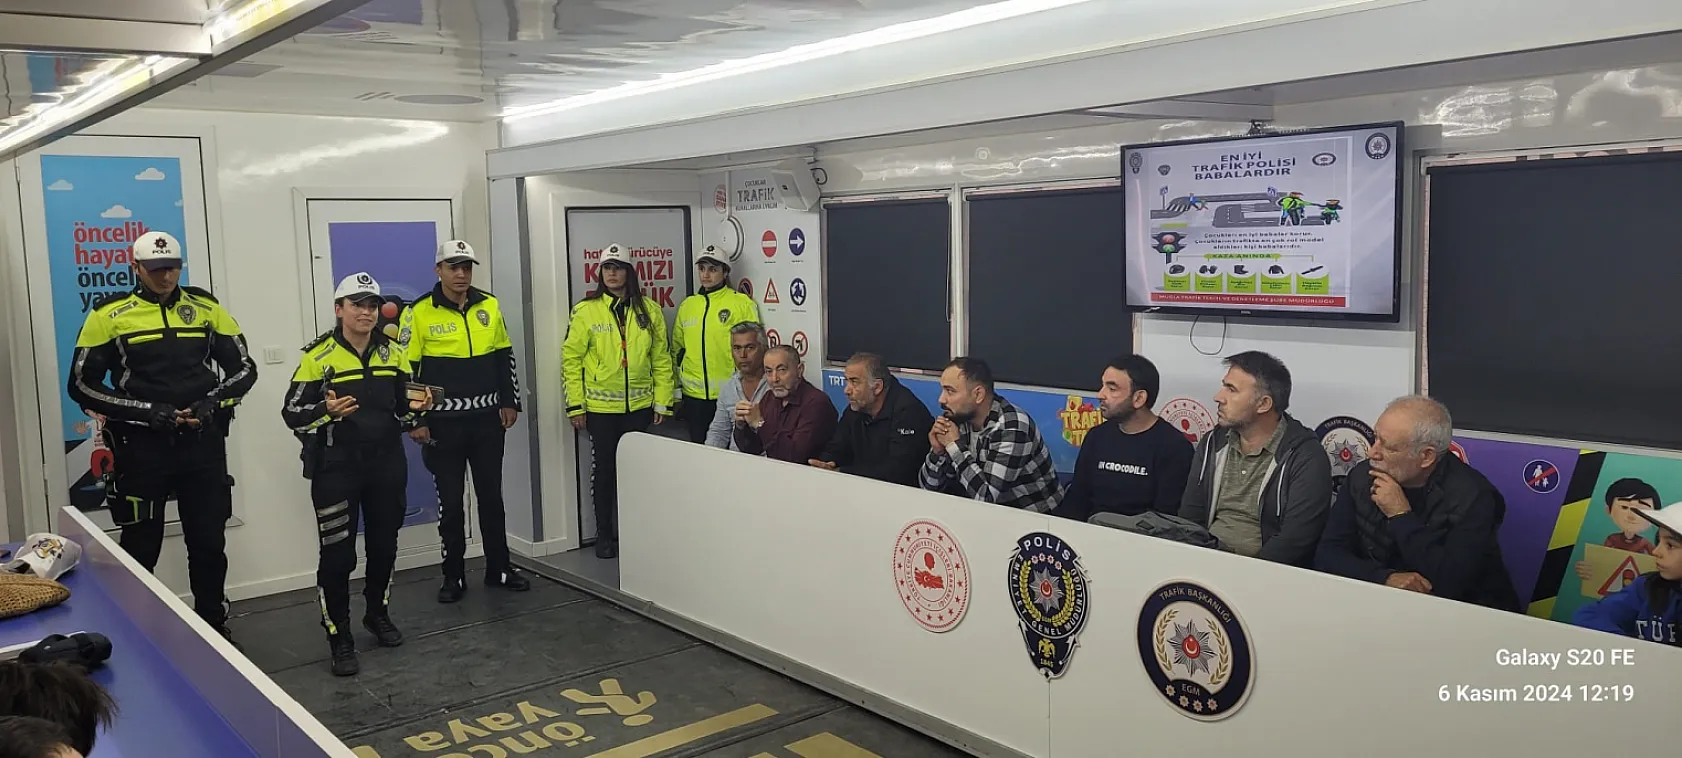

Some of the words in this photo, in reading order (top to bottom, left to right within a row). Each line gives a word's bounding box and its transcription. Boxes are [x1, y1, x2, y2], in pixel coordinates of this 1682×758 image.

[1220, 155, 1238, 163] EN
[1240, 150, 1262, 161] İYİ
[1191, 161, 1244, 173] TRAFİK
[1246, 157, 1296, 170] POLİSİ
[1194, 167, 1291, 181] BABALARDIR
[736, 187, 775, 202] TRAFİK
[73, 243, 134, 270] hayat
[78, 266, 134, 288] öncel
[428, 322, 457, 336] POLİS
[1023, 536, 1072, 561] POLİS
[1159, 586, 1185, 601] TRAFİK
[1187, 588, 1231, 623] BAŞKANLIĞI
[1031, 620, 1062, 635] GENEL
[1181, 683, 1200, 696] EGM
[403, 701, 561, 751] yaya
